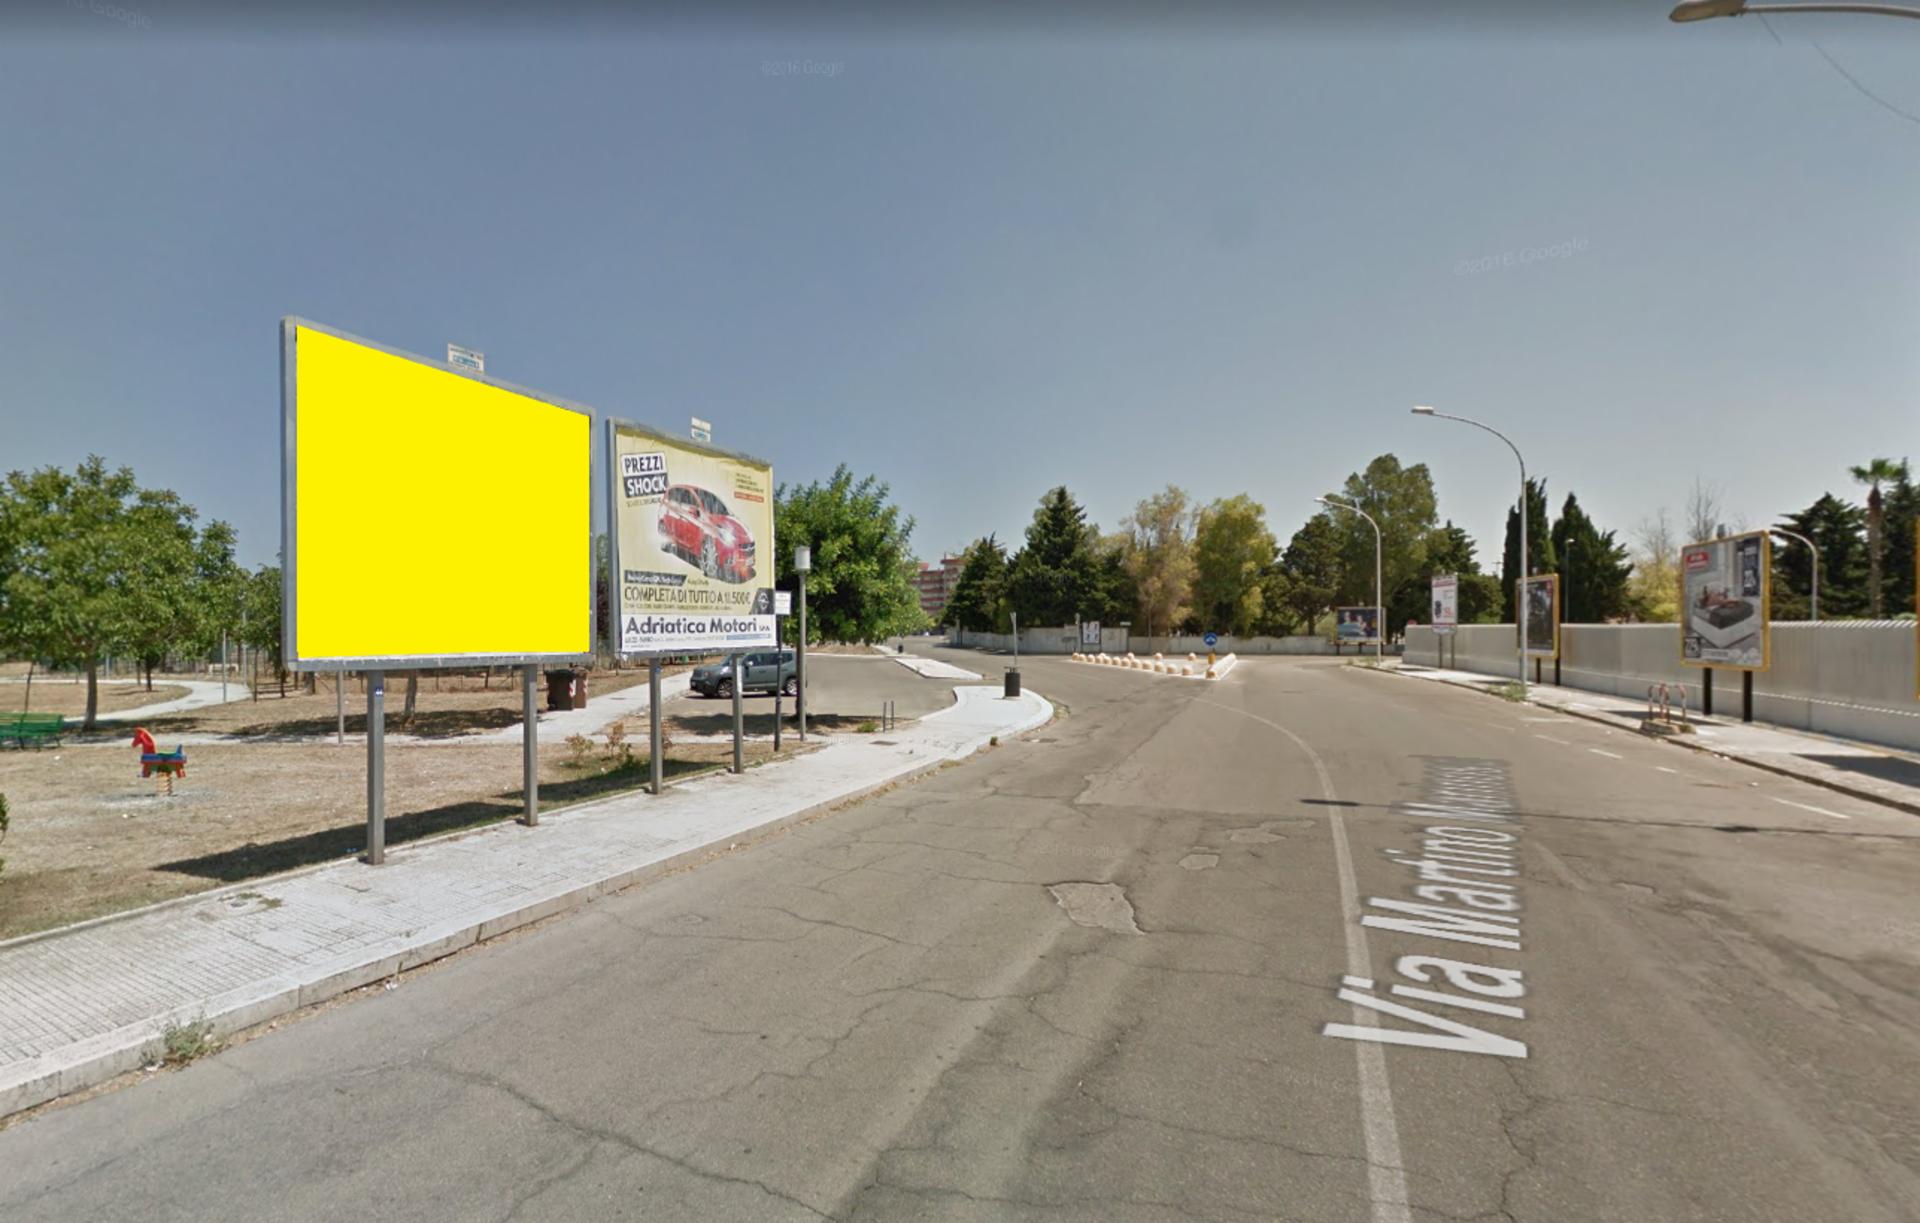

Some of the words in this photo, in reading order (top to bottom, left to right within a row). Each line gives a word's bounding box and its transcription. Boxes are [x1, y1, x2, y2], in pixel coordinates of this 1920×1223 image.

[624, 455, 663, 473] PREZZI
[627, 475, 667, 497] SHOCK
[624, 585, 677, 602] COMPLETA
[687, 588, 717, 604] TUTTO
[625, 616, 706, 635] Adriatica
[709, 618, 757, 633] Motori
